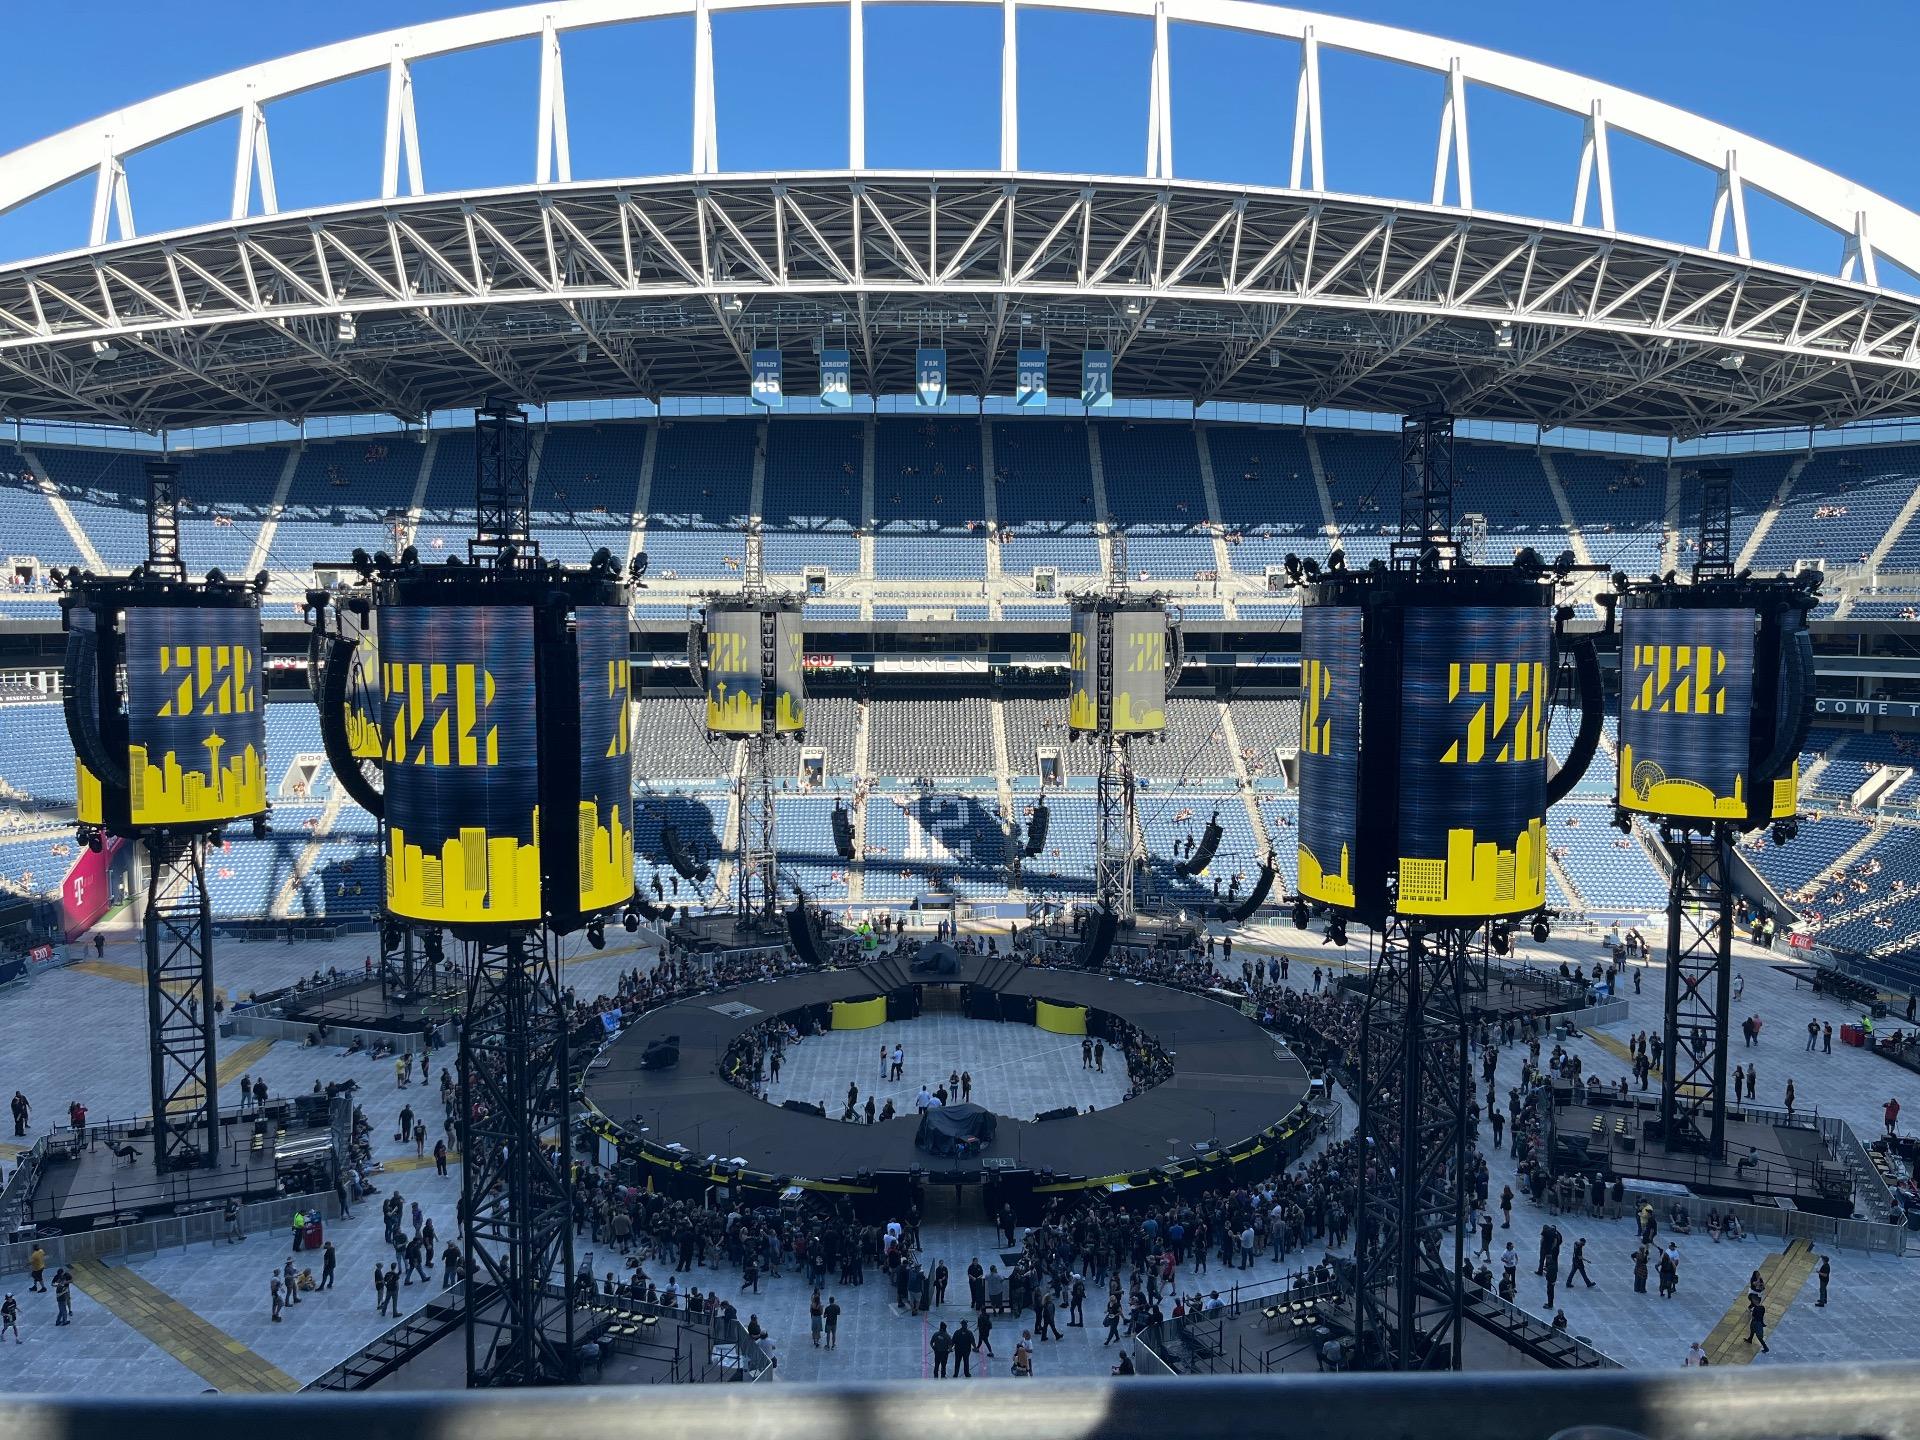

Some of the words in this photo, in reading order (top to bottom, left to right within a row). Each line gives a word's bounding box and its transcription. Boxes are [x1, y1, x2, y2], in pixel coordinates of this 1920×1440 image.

[754, 371, 780, 393] 45
[822, 371, 847, 393] 80
[920, 370, 942, 392] 12
[1019, 371, 1044, 393] 96
[1086, 372, 1108, 393] 71
[883, 656, 981, 672] LUMEN
[74, 876, 84, 906] T
[1795, 935, 1809, 947] EXIT
[33, 947, 48, 960] EXIT
